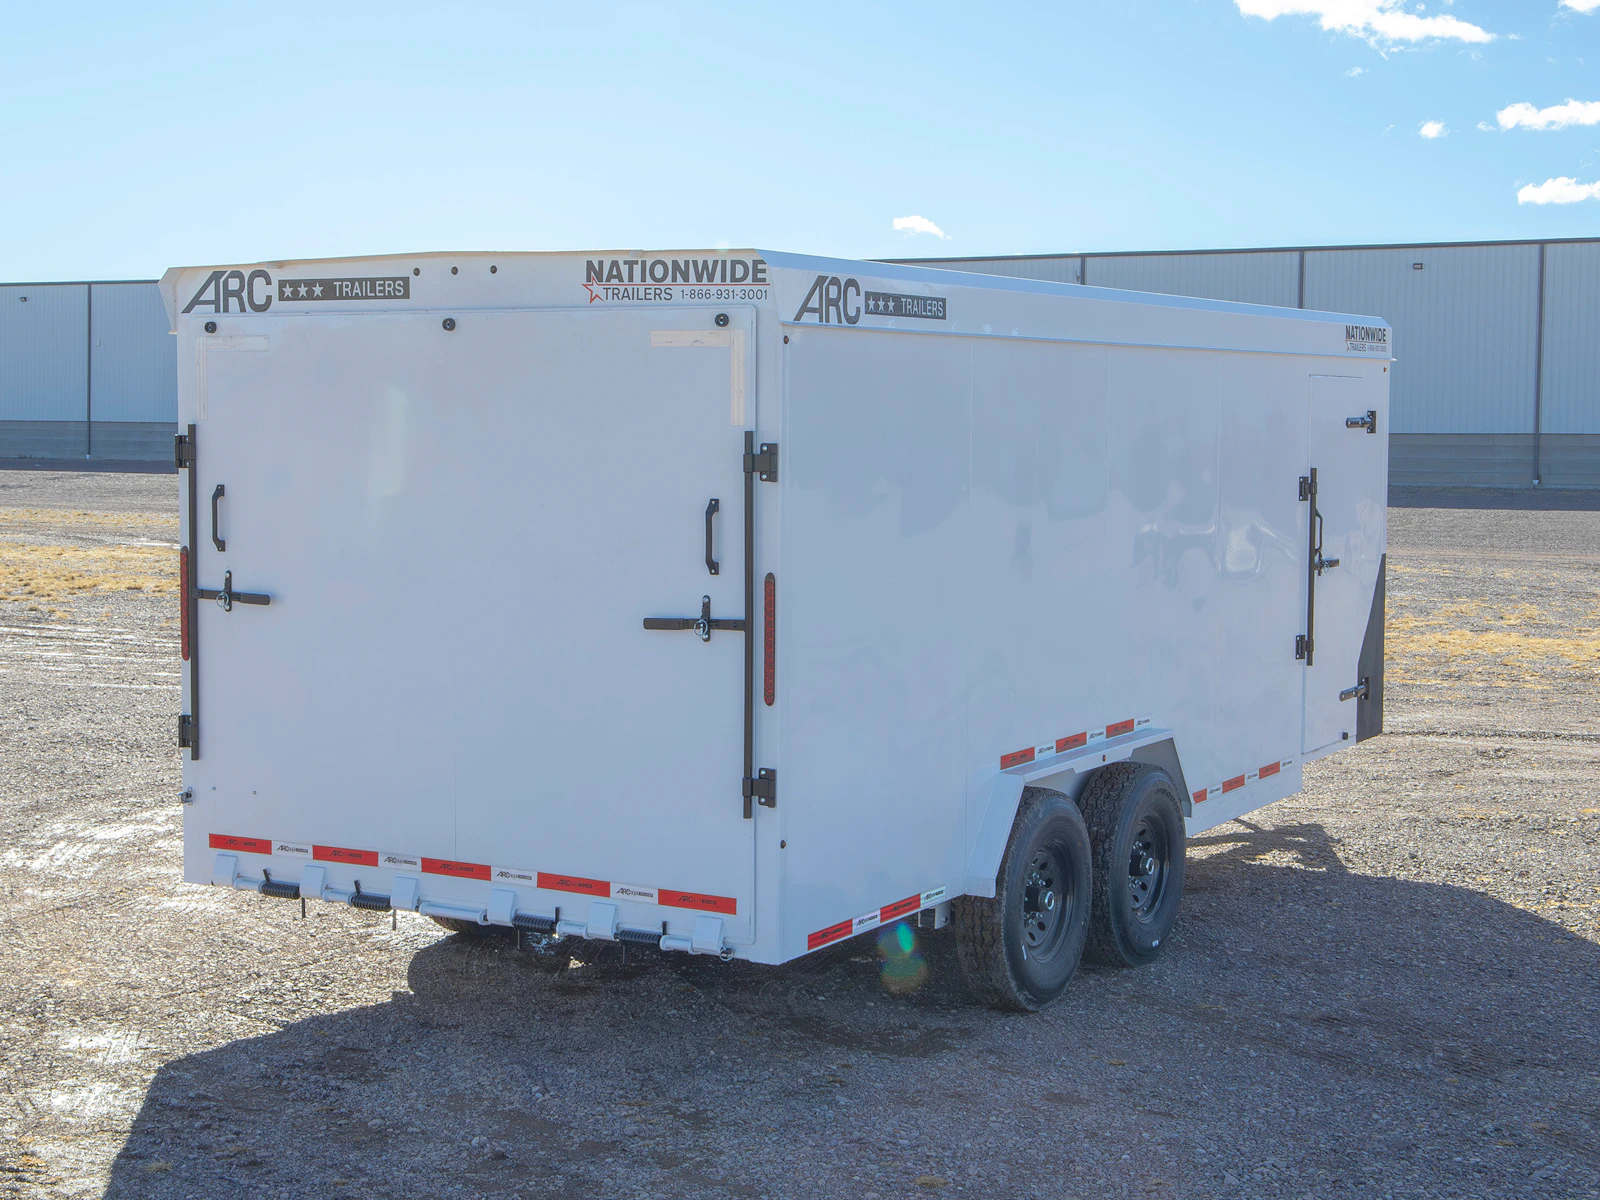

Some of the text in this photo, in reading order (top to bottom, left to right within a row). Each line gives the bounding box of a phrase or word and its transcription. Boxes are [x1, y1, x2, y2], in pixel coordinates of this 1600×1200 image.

[586, 259, 767, 283] NATIONWIDE
[181, 269, 404, 314] ARC TRAILERS
[603, 287, 768, 301] TRAILERS 1-866-931-3001
[793, 275, 944, 325] ARC TRAILERS
[1345, 325, 1387, 342] NATIONWIDE
